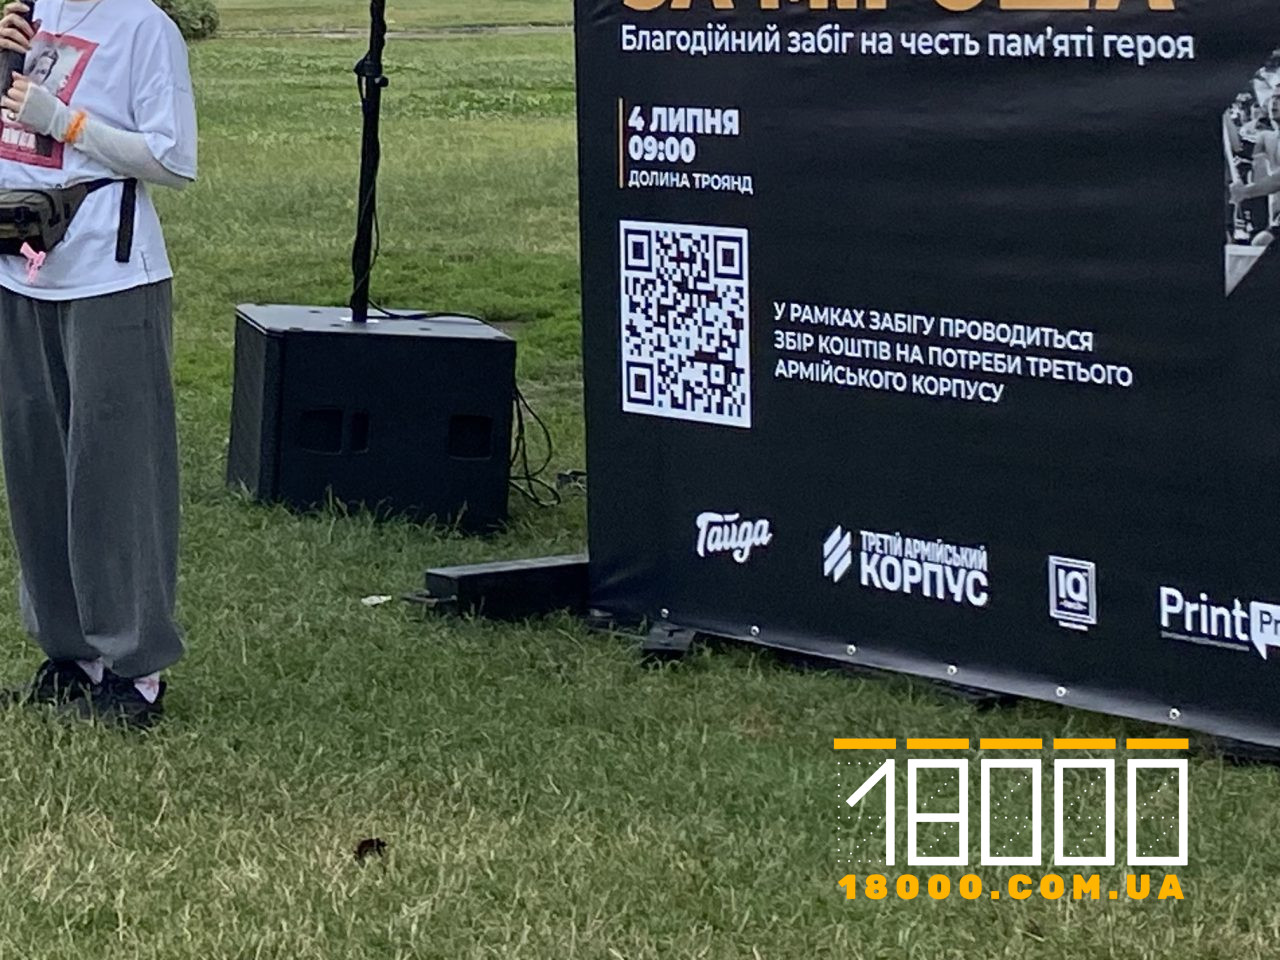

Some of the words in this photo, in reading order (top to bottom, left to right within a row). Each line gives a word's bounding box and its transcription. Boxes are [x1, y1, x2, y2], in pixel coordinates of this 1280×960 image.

[621, 23, 780, 55] Благодійний
[787, 24, 855, 54] забіг
[861, 31, 893, 55] на
[900, 32, 981, 57] честь
[1103, 34, 1195, 65] героя
[628, 106, 645, 131] 4
[649, 106, 739, 135] ЛИПНЯ
[628, 135, 696, 163] 09:00
[628, 170, 690, 188] ДОЛИНА
[692, 173, 753, 195] ТРОЯНД
[773, 301, 785, 321] У
[790, 303, 865, 328] РАМКАХ
[869, 311, 935, 335] ЗАБІГУ
[940, 318, 1093, 352] ПРОВОДИТЬСЯ
[774, 330, 814, 351] ЗБІР
[819, 335, 891, 360] КОШТІВ
[896, 343, 924, 365] НА
[928, 346, 1021, 374] ПОТРЕБИ
[1025, 357, 1132, 387] ТРЕТЬОГО
[774, 359, 907, 392] АРМІЙСЬКОГО
[912, 374, 1004, 403] КОРПУСУ
[860, 530, 903, 556] ТРЕТІЙ
[904, 537, 988, 572] АРМІЙСЬКИЙ
[860, 552, 988, 606] КОРПУС
[1160, 586, 1250, 641] Print
